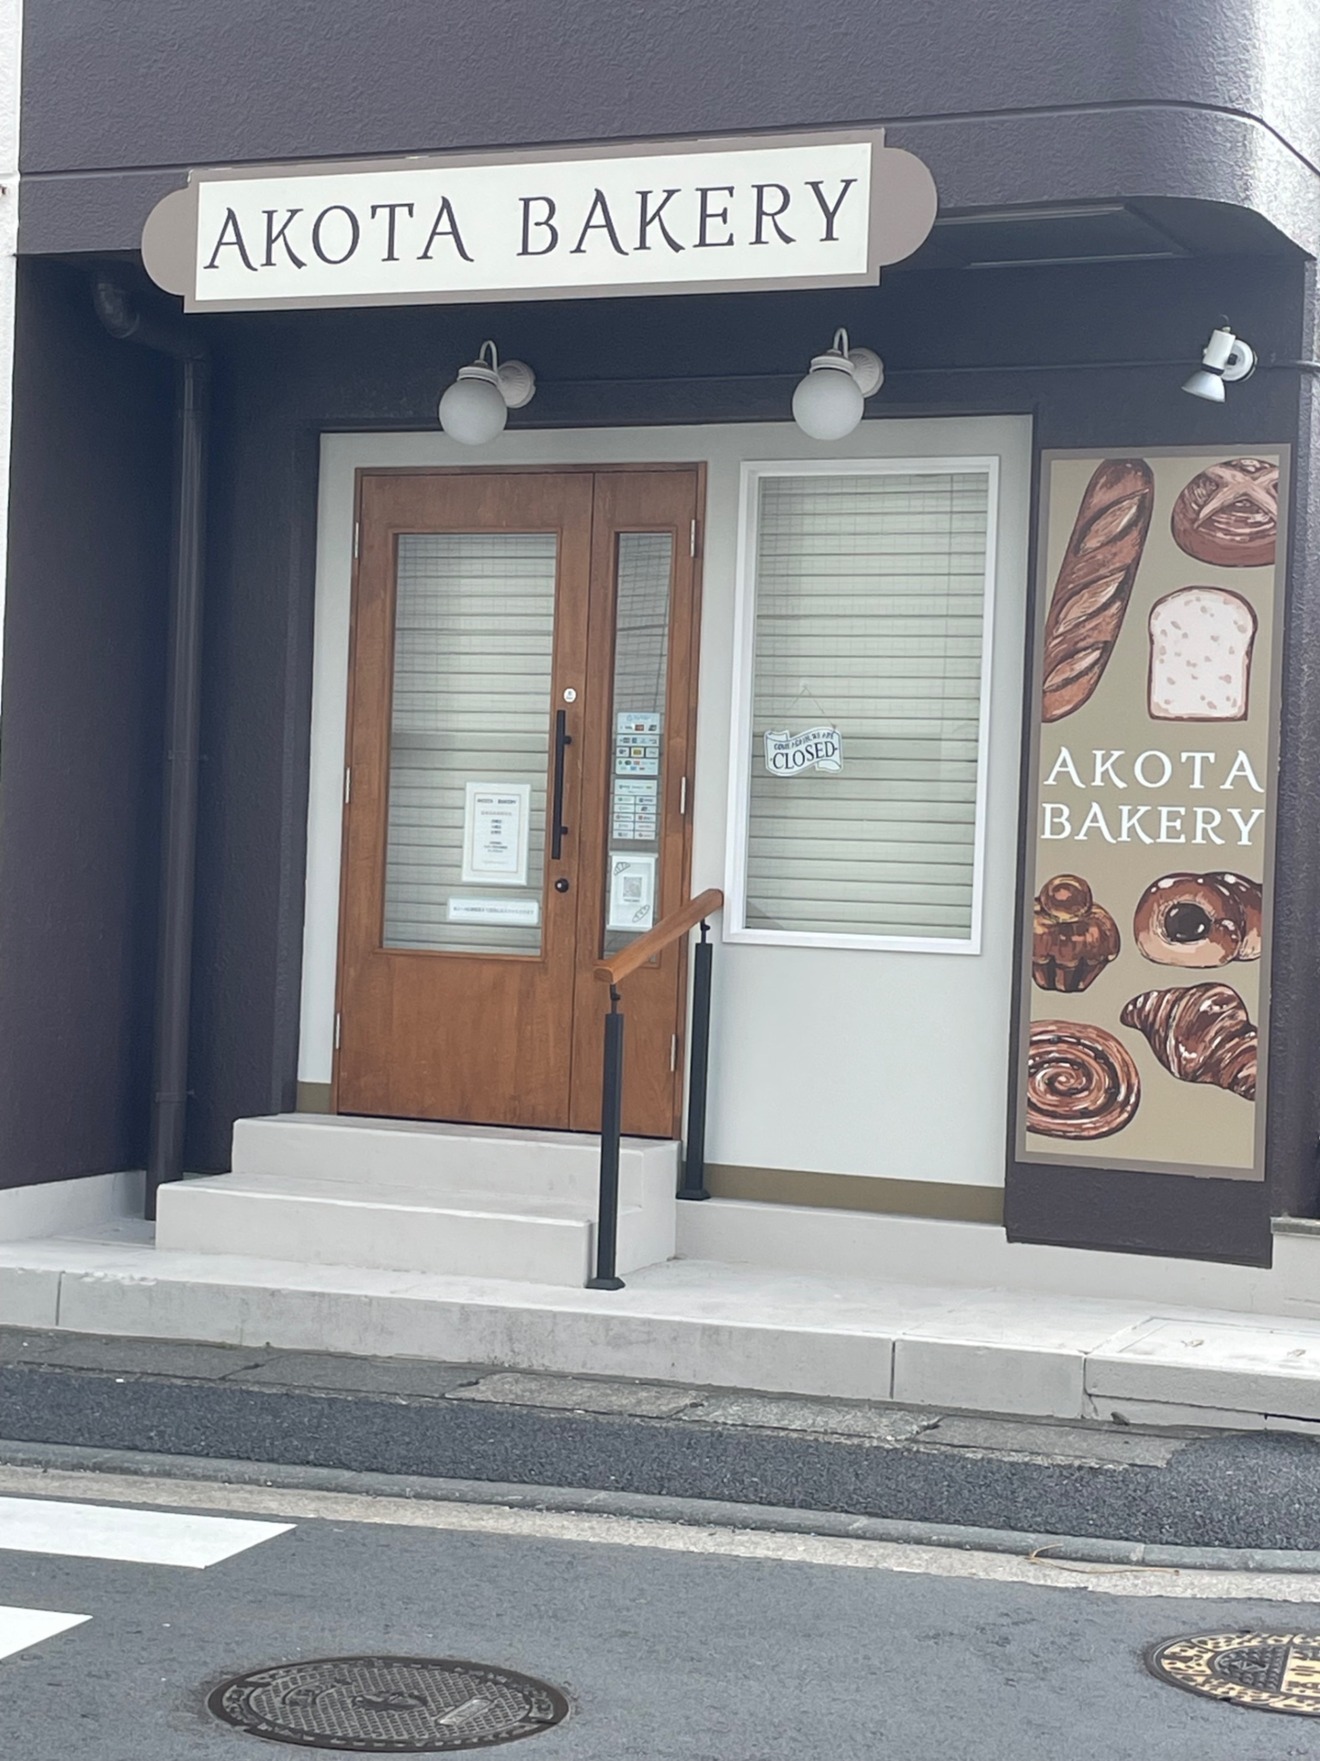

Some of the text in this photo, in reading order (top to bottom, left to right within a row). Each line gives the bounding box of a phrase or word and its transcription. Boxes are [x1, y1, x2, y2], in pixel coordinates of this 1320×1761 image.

[204, 178, 857, 271] AKOTA BAKERY
[773, 741, 835, 769] CLOSED
[1043, 747, 1265, 793] AKOTA
[1040, 802, 1265, 846] BAKERY
